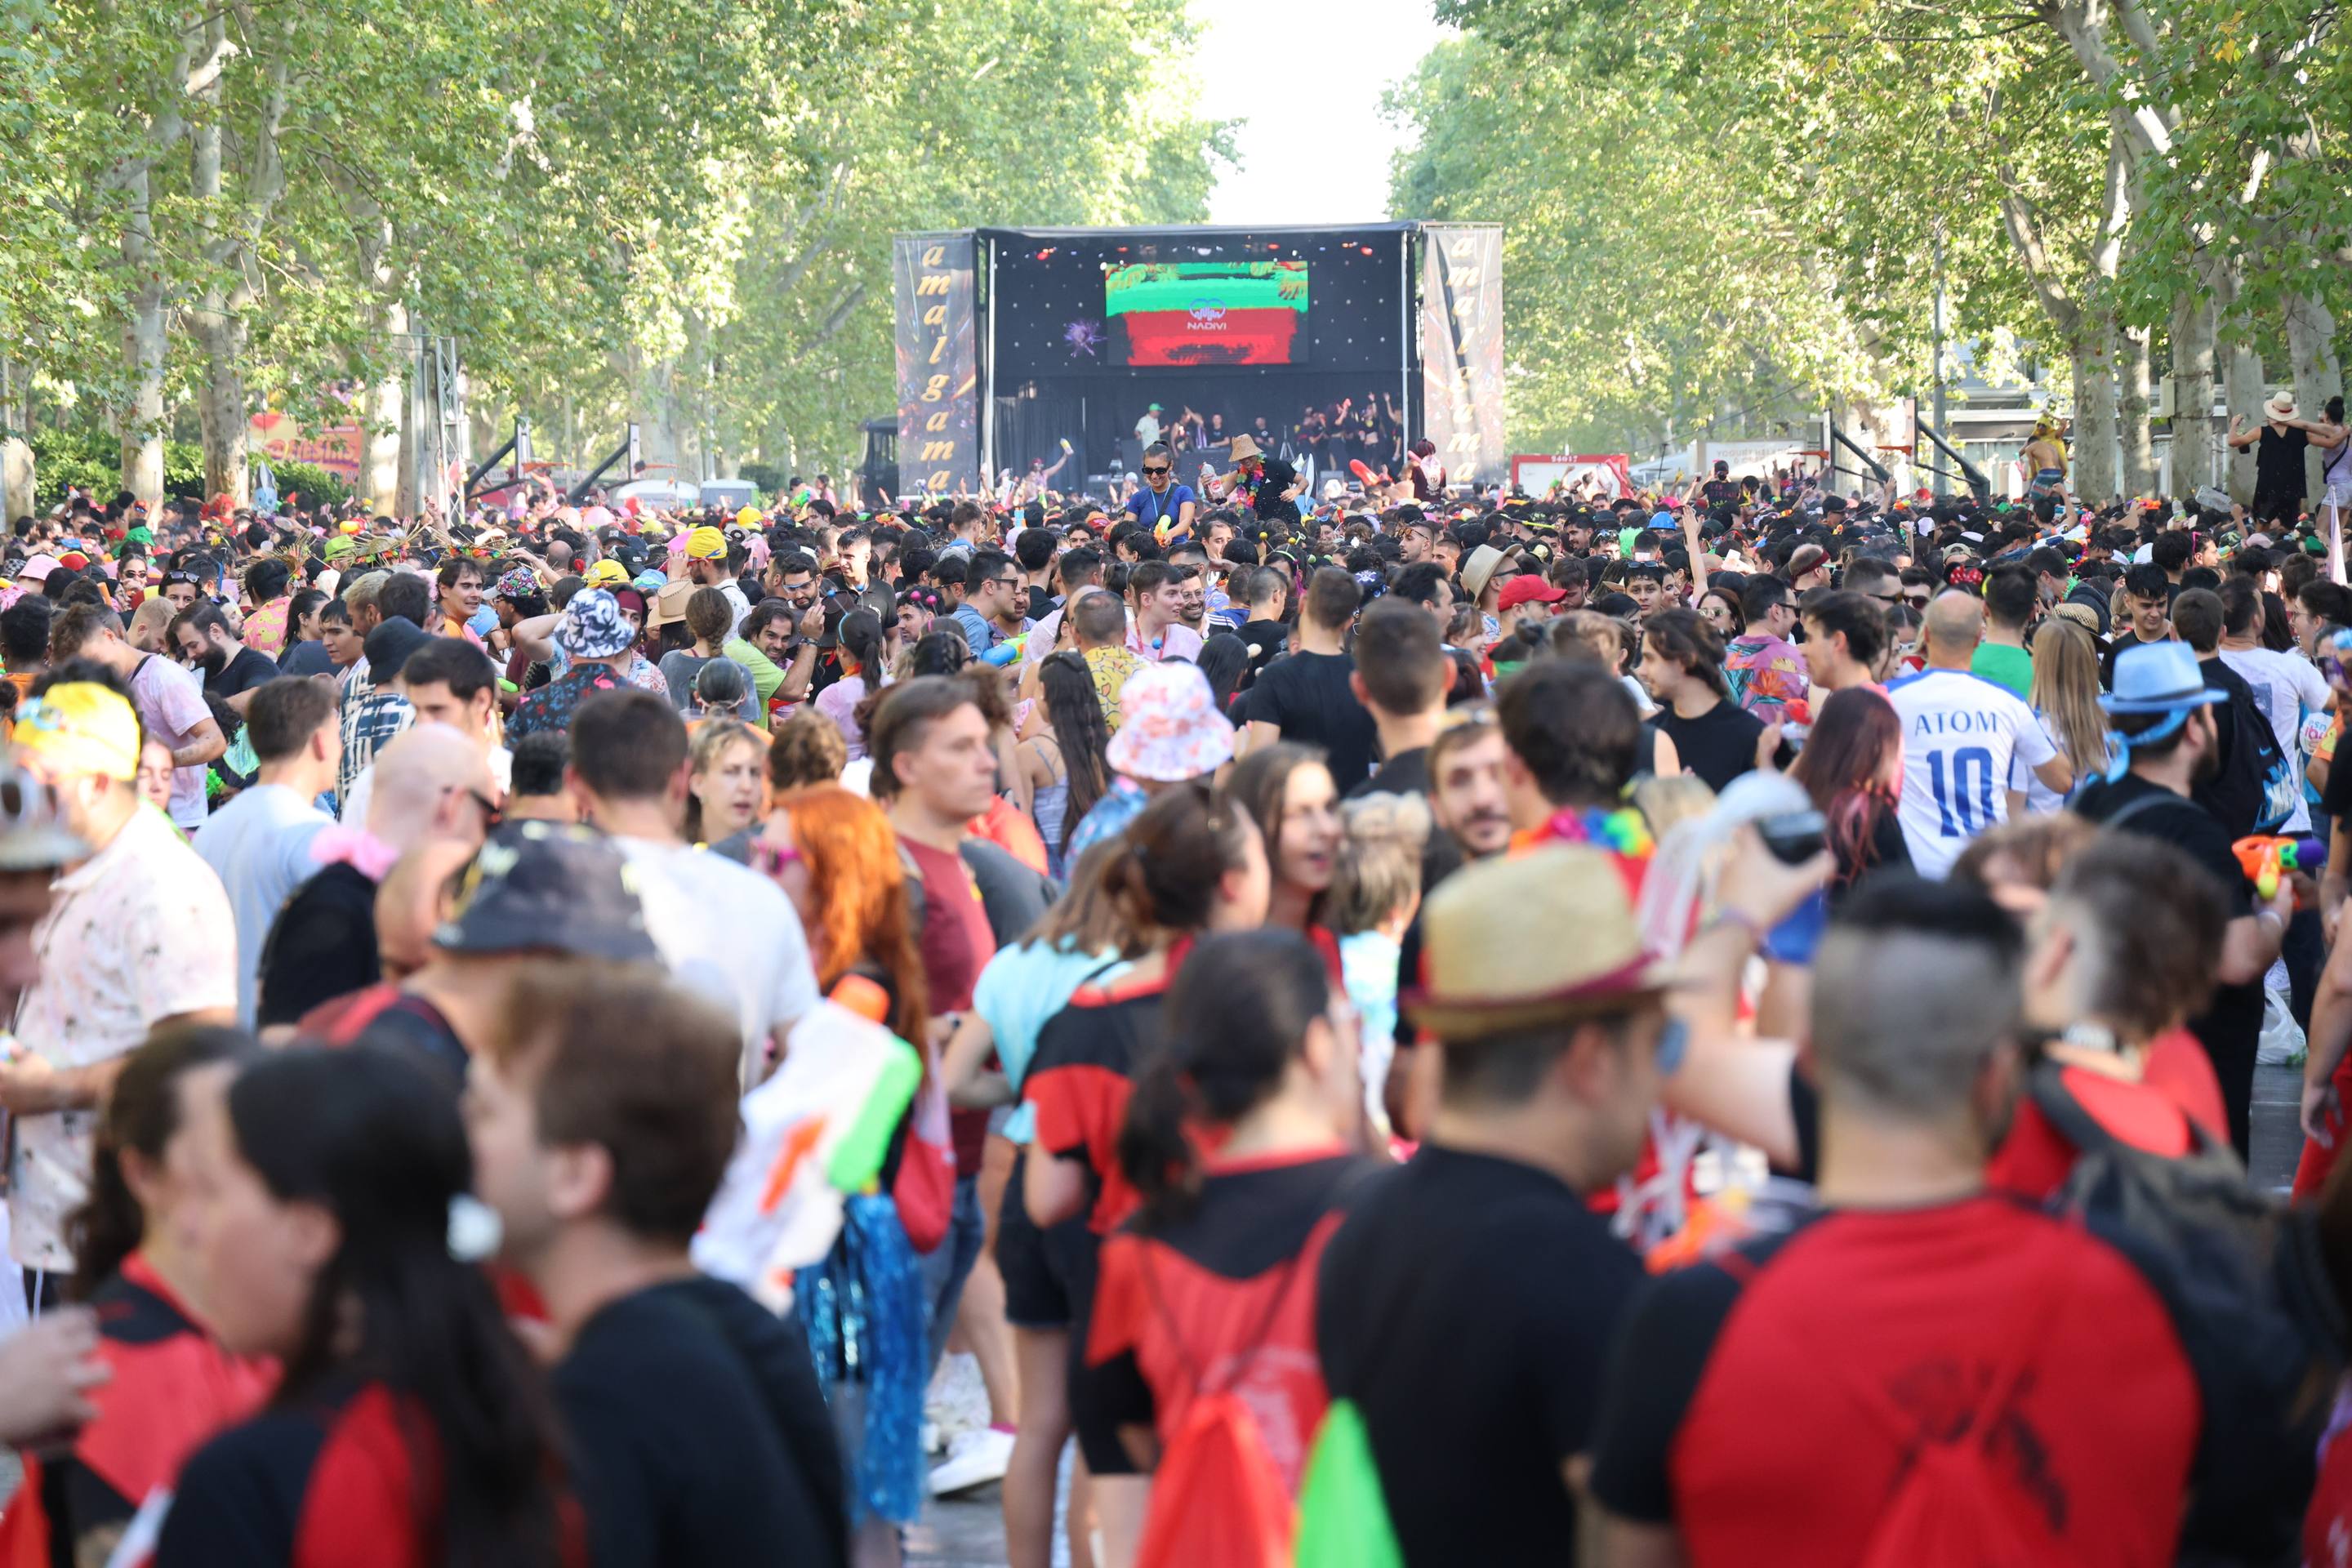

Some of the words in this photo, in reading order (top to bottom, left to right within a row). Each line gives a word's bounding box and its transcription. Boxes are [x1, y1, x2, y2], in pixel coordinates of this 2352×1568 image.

[1187, 322, 1227, 330] NADIVI
[916, 245, 954, 490] amalgama
[1915, 710, 1997, 737] ATOM
[1927, 746, 1997, 837] 10
